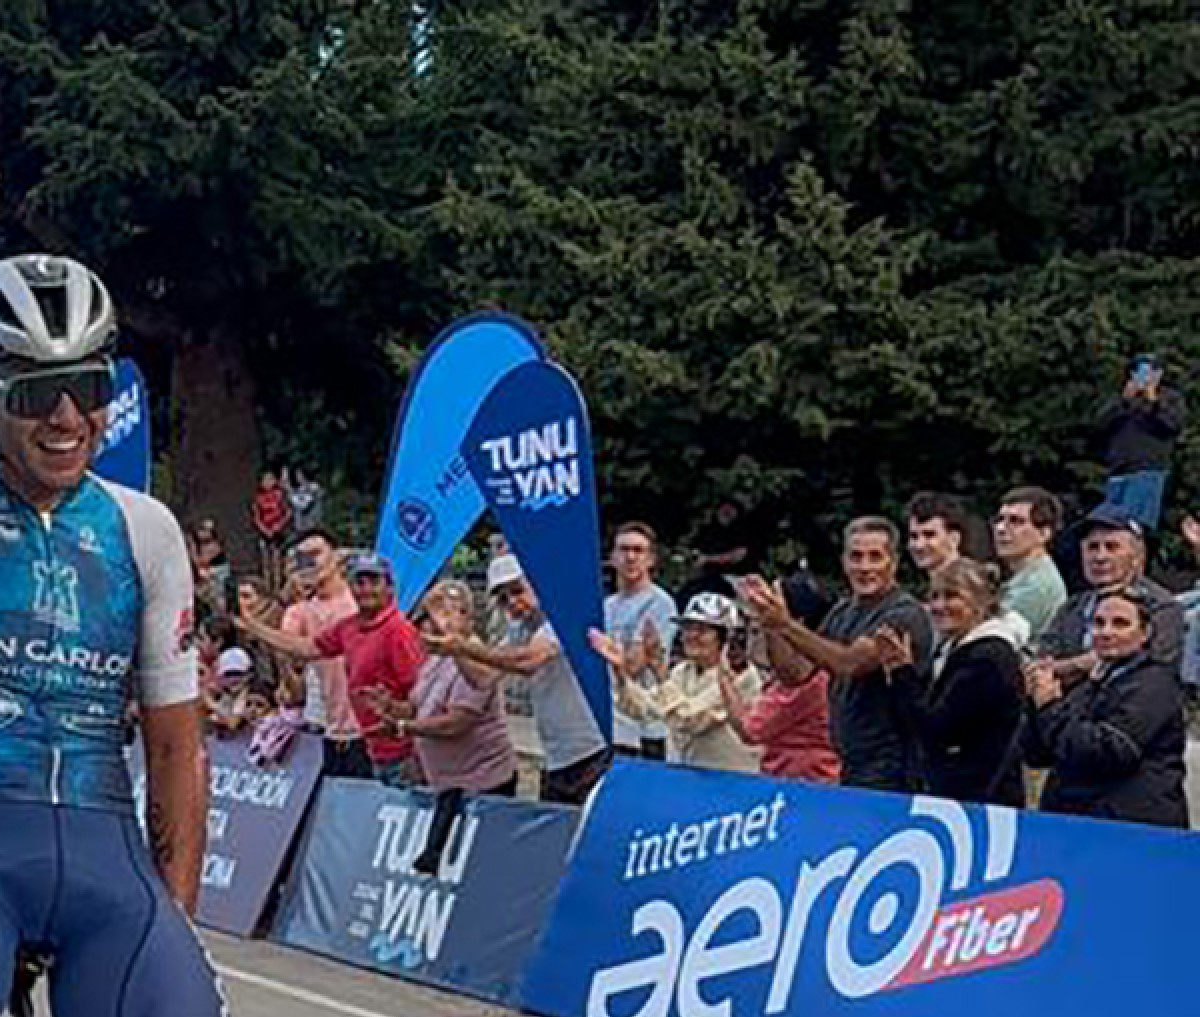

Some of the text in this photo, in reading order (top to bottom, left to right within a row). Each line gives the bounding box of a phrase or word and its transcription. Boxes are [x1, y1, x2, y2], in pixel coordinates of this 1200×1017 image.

[480, 416, 576, 471] TUNU
[513, 459, 581, 499] YAN
[624, 793, 785, 880] internet
[379, 879, 457, 961] YAN
[922, 902, 1044, 972] Fiber
